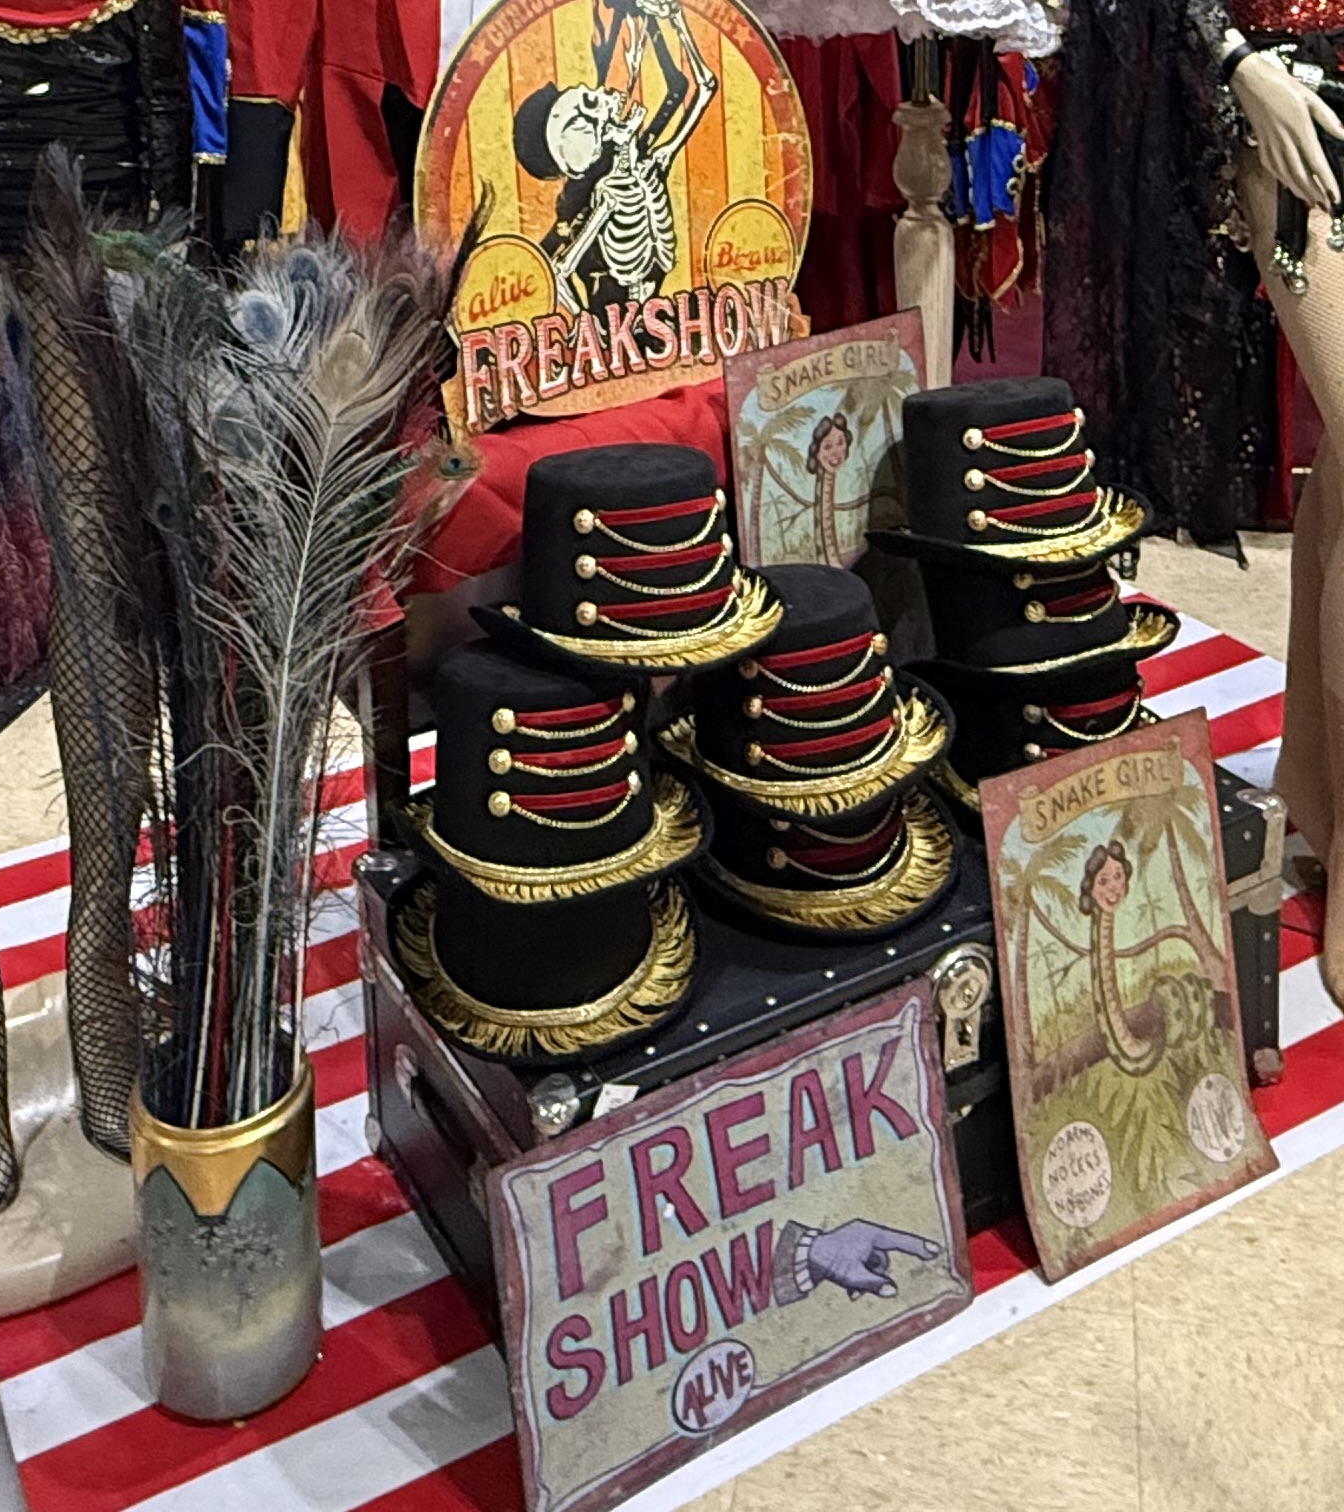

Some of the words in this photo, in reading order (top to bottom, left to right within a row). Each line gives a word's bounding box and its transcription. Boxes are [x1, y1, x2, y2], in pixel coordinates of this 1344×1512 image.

[459, 278, 794, 432] FREAKSHOW
[770, 352, 834, 402] SNAKE
[843, 344, 889, 369] GIRL
[1035, 771, 1106, 831] SNAKE
[1116, 757, 1174, 788] GIRL
[548, 1036, 919, 1302] FREAK
[1048, 1166, 1068, 1185] NO
[545, 1219, 776, 1421] SHOW
[680, 1347, 752, 1428] ALIVE
